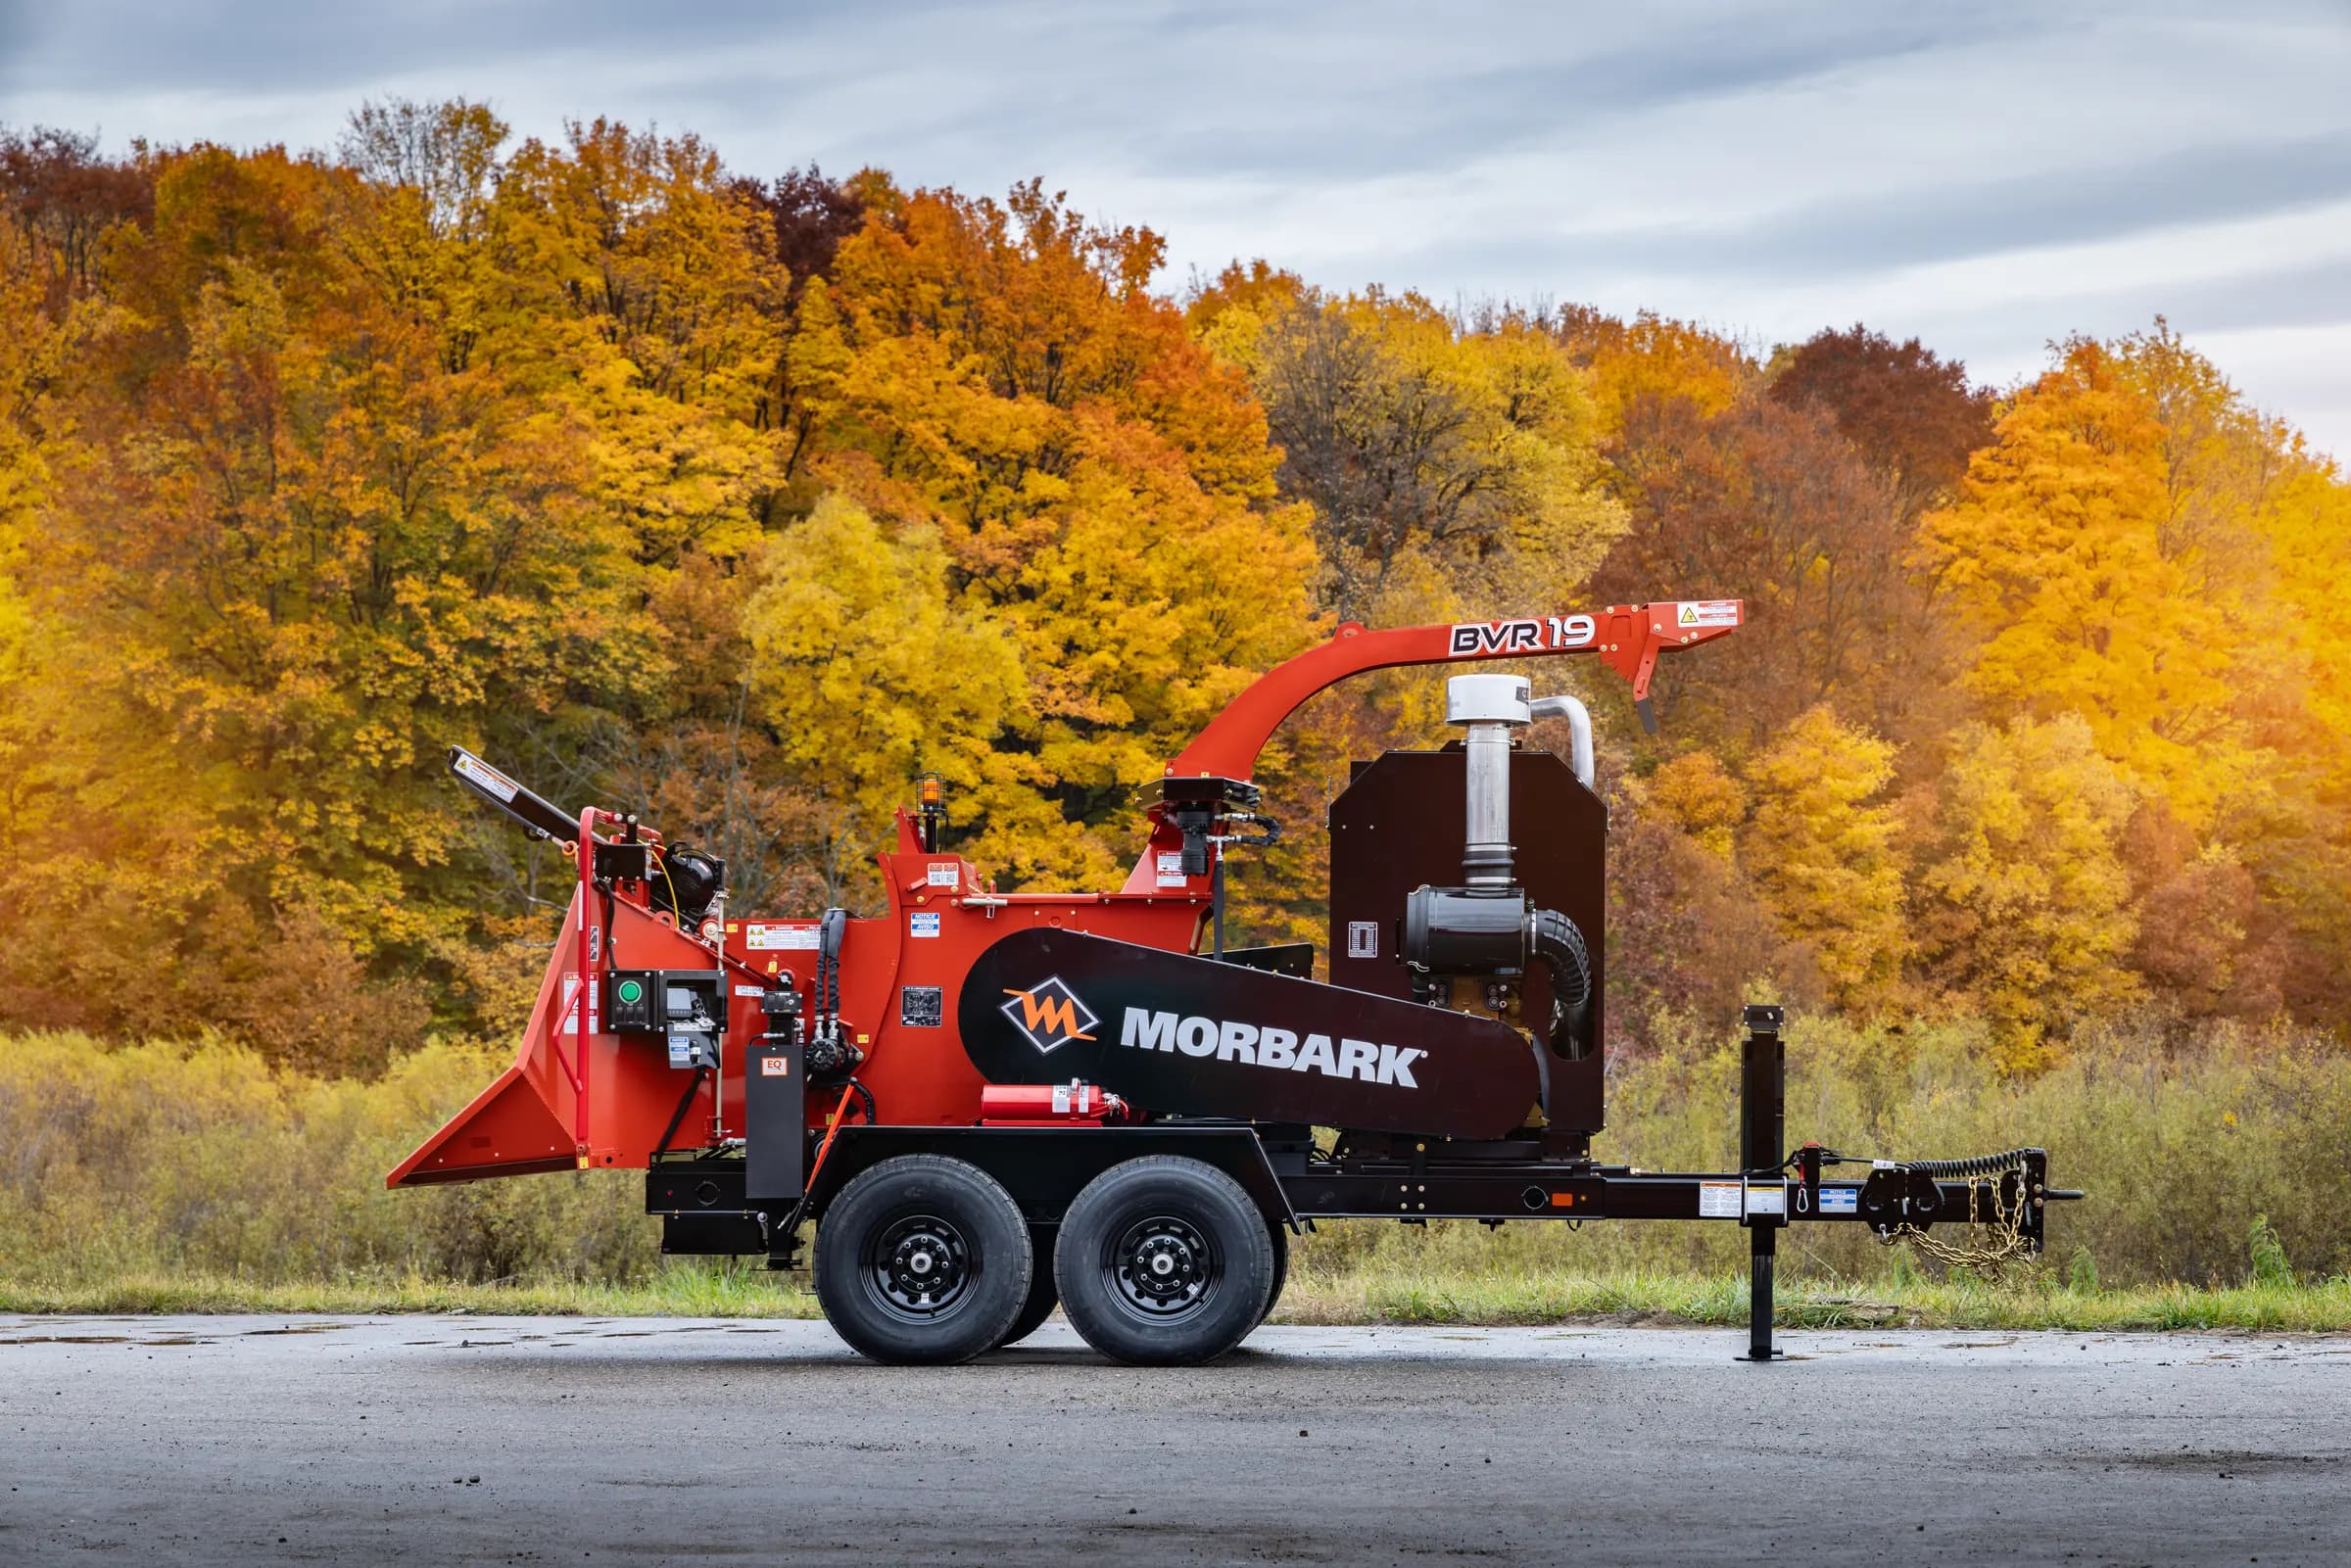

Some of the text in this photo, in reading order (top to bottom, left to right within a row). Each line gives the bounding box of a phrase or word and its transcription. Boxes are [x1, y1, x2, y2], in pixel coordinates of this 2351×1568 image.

[1450, 615, 1596, 655] BVR 19
[767, 1060, 782, 1070] EQ
[1121, 1006, 1423, 1089] MORBARK
